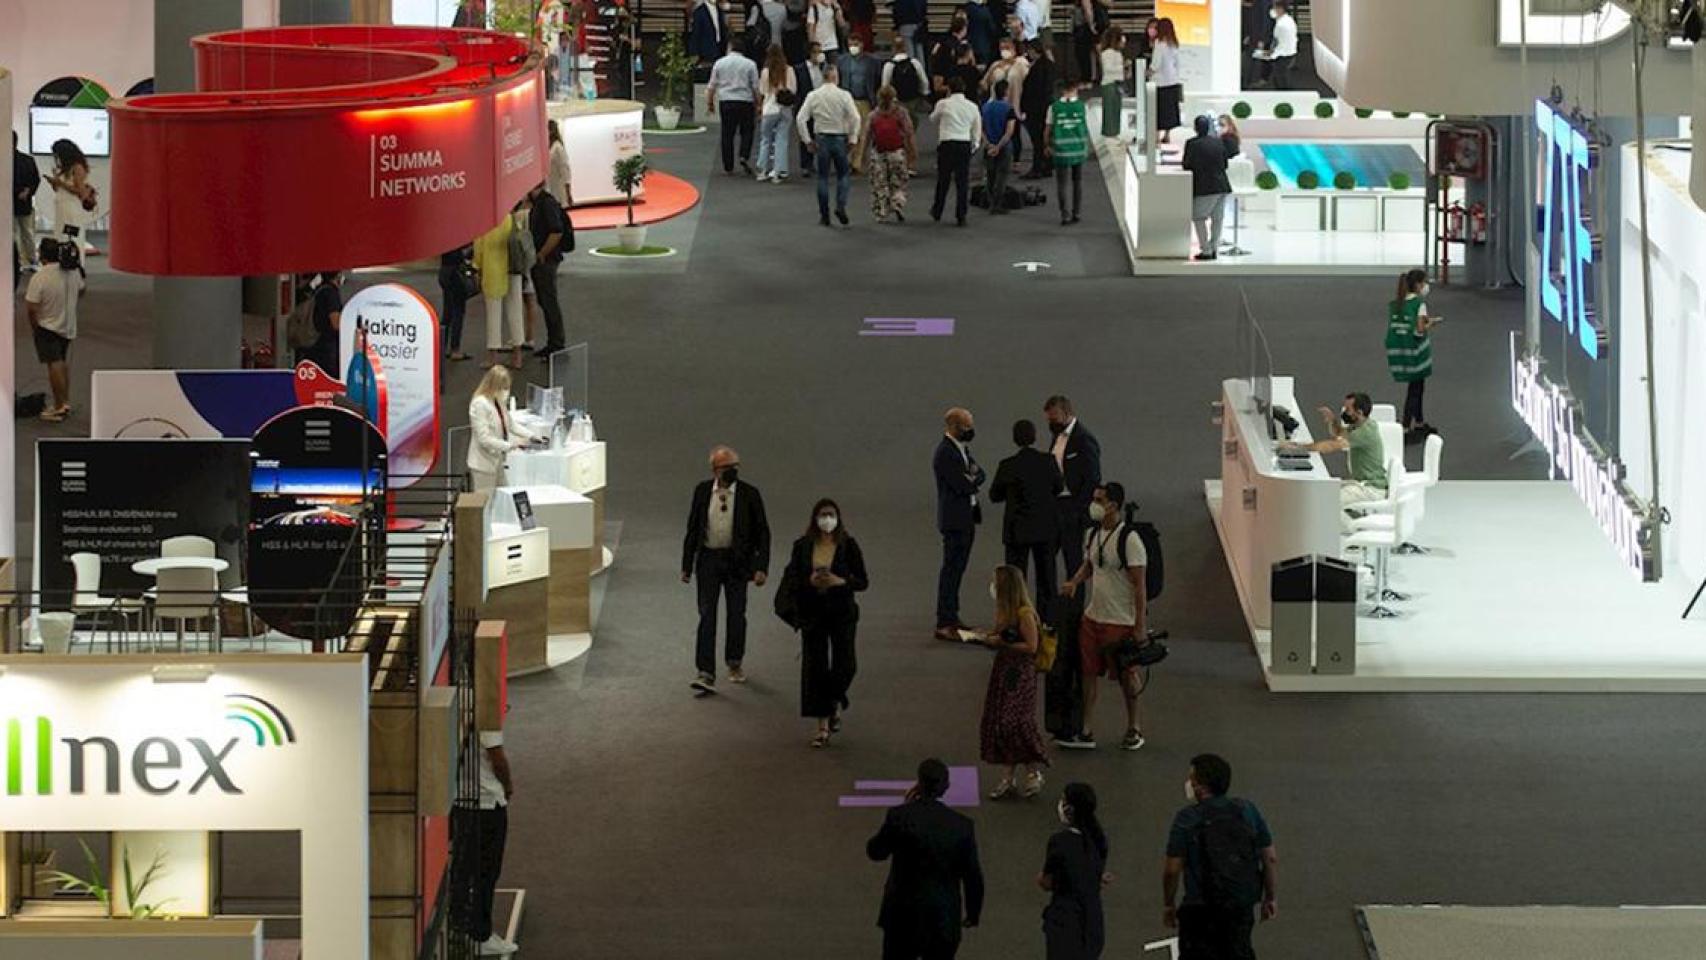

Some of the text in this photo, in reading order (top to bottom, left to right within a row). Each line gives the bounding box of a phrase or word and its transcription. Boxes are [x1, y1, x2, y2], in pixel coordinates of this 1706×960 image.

[379, 134, 398, 150] 03
[379, 149, 443, 172] SUMMA
[379, 170, 467, 197] NETWORKS
[1536, 99, 1597, 360] ZTE
[298, 367, 317, 380] 05
